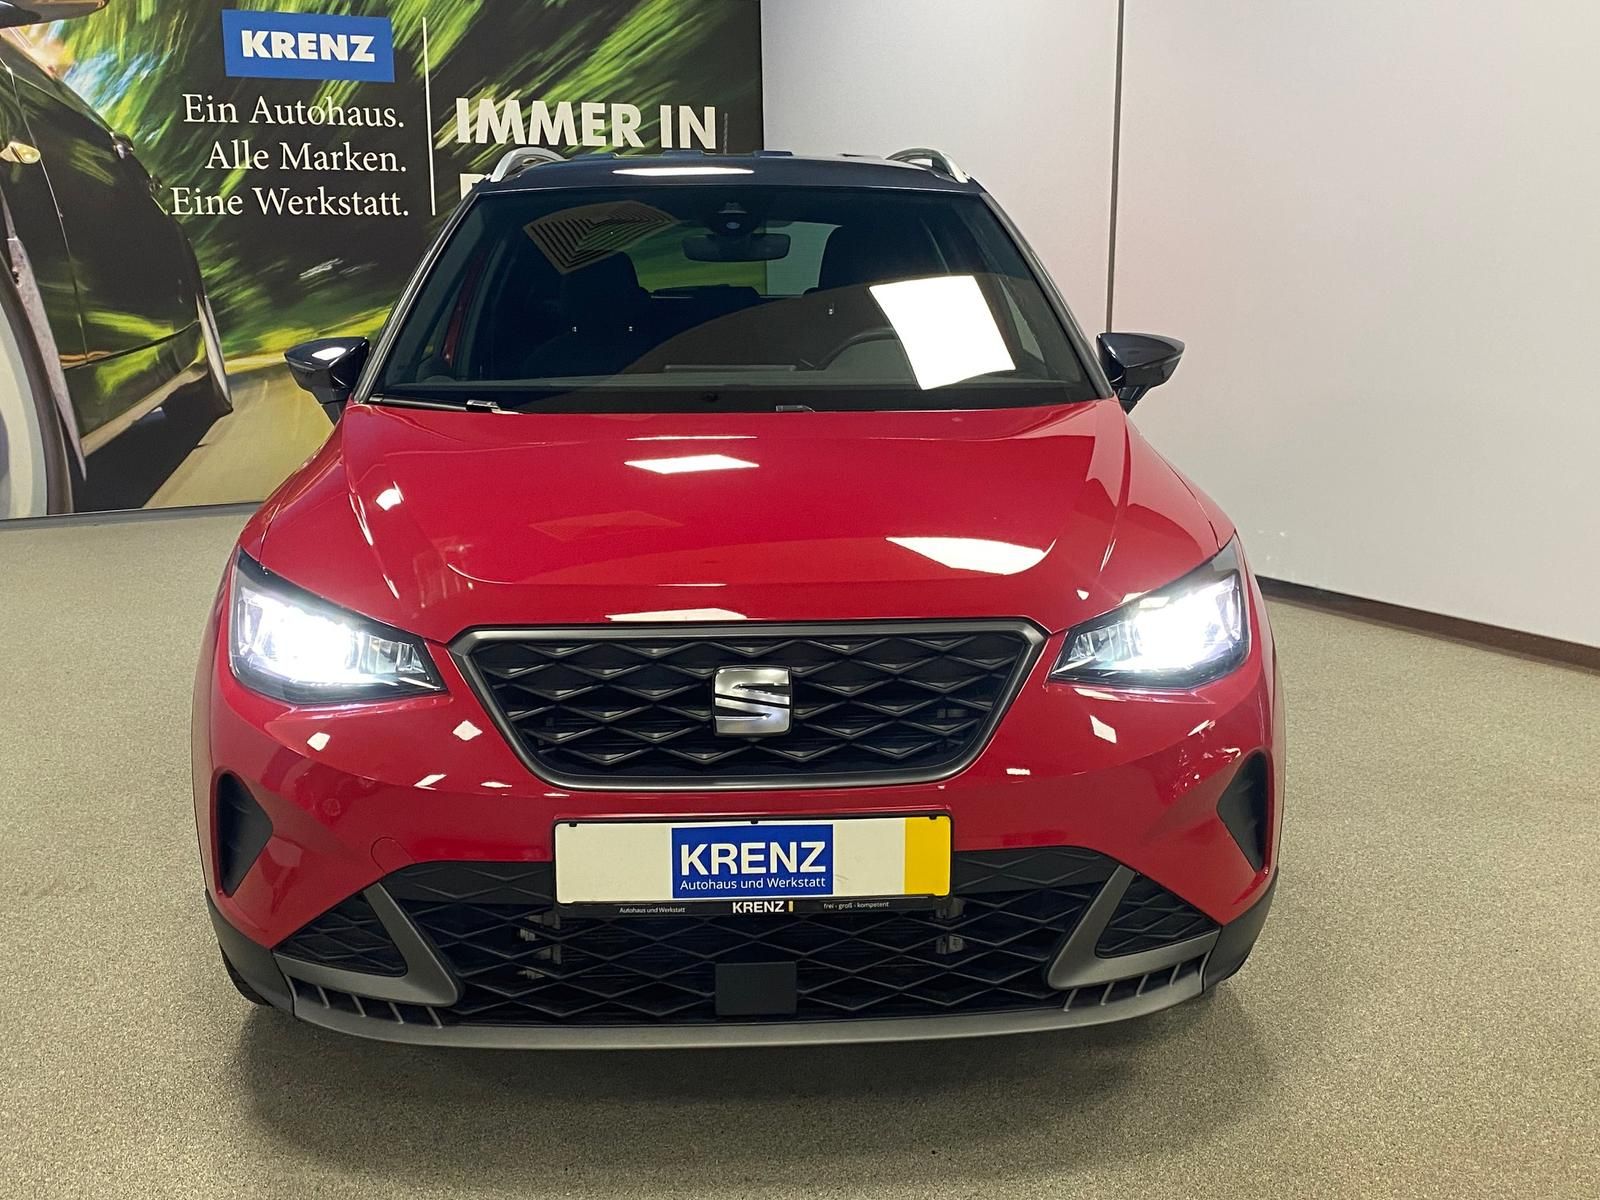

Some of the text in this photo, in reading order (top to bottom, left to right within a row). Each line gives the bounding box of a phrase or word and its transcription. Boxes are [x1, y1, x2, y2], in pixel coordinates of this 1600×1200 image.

[241, 30, 375, 62] KRENZ
[183, 93, 404, 128] Ein Autohaus.
[456, 97, 645, 148] IMMER
[660, 104, 716, 149] IN
[205, 139, 406, 172] Alle Marken.
[170, 186, 409, 216] Eine Werkstatt.
[680, 841, 826, 876] KRENZ
[680, 877, 826, 890] Autohaus und Werkstatt
[732, 901, 784, 913] KRENZ
[856, 901, 888, 909] kompetent
